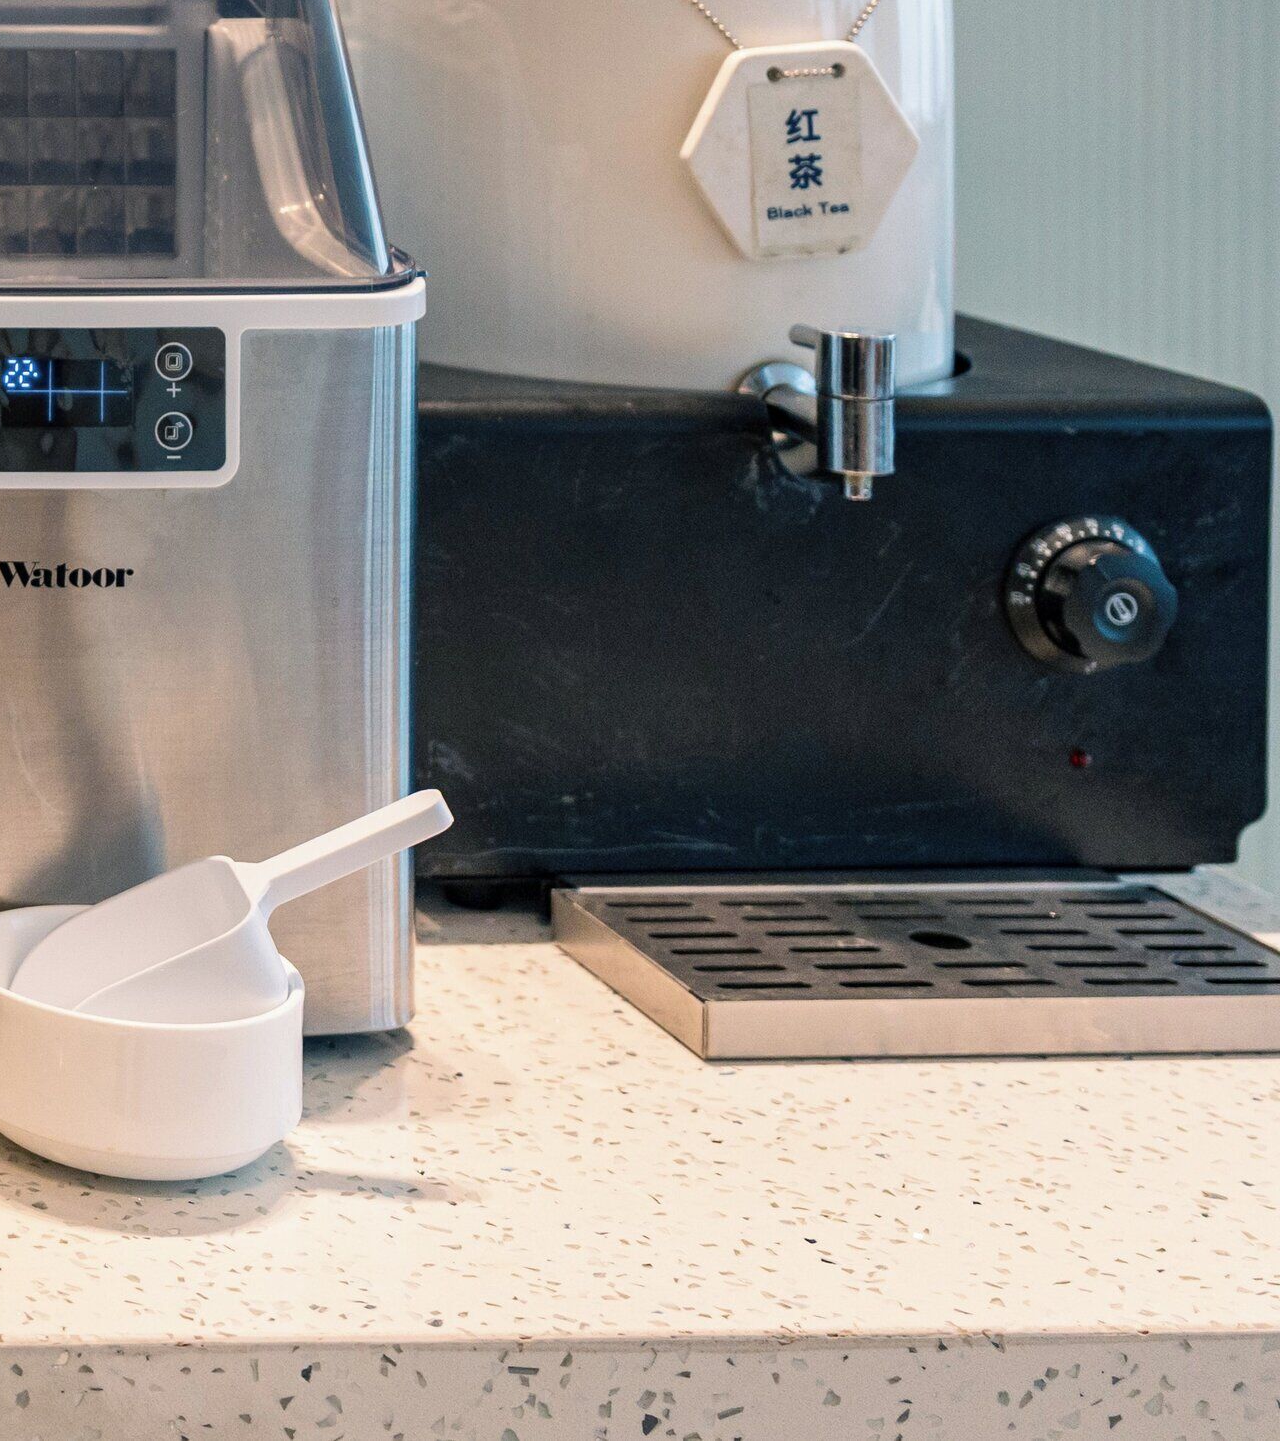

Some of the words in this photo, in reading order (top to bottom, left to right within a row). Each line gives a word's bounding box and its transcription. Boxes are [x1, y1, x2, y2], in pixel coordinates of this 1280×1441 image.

[785, 109, 823, 190] 红茶
[766, 204, 813, 221] Black
[818, 201, 850, 215] Tea
